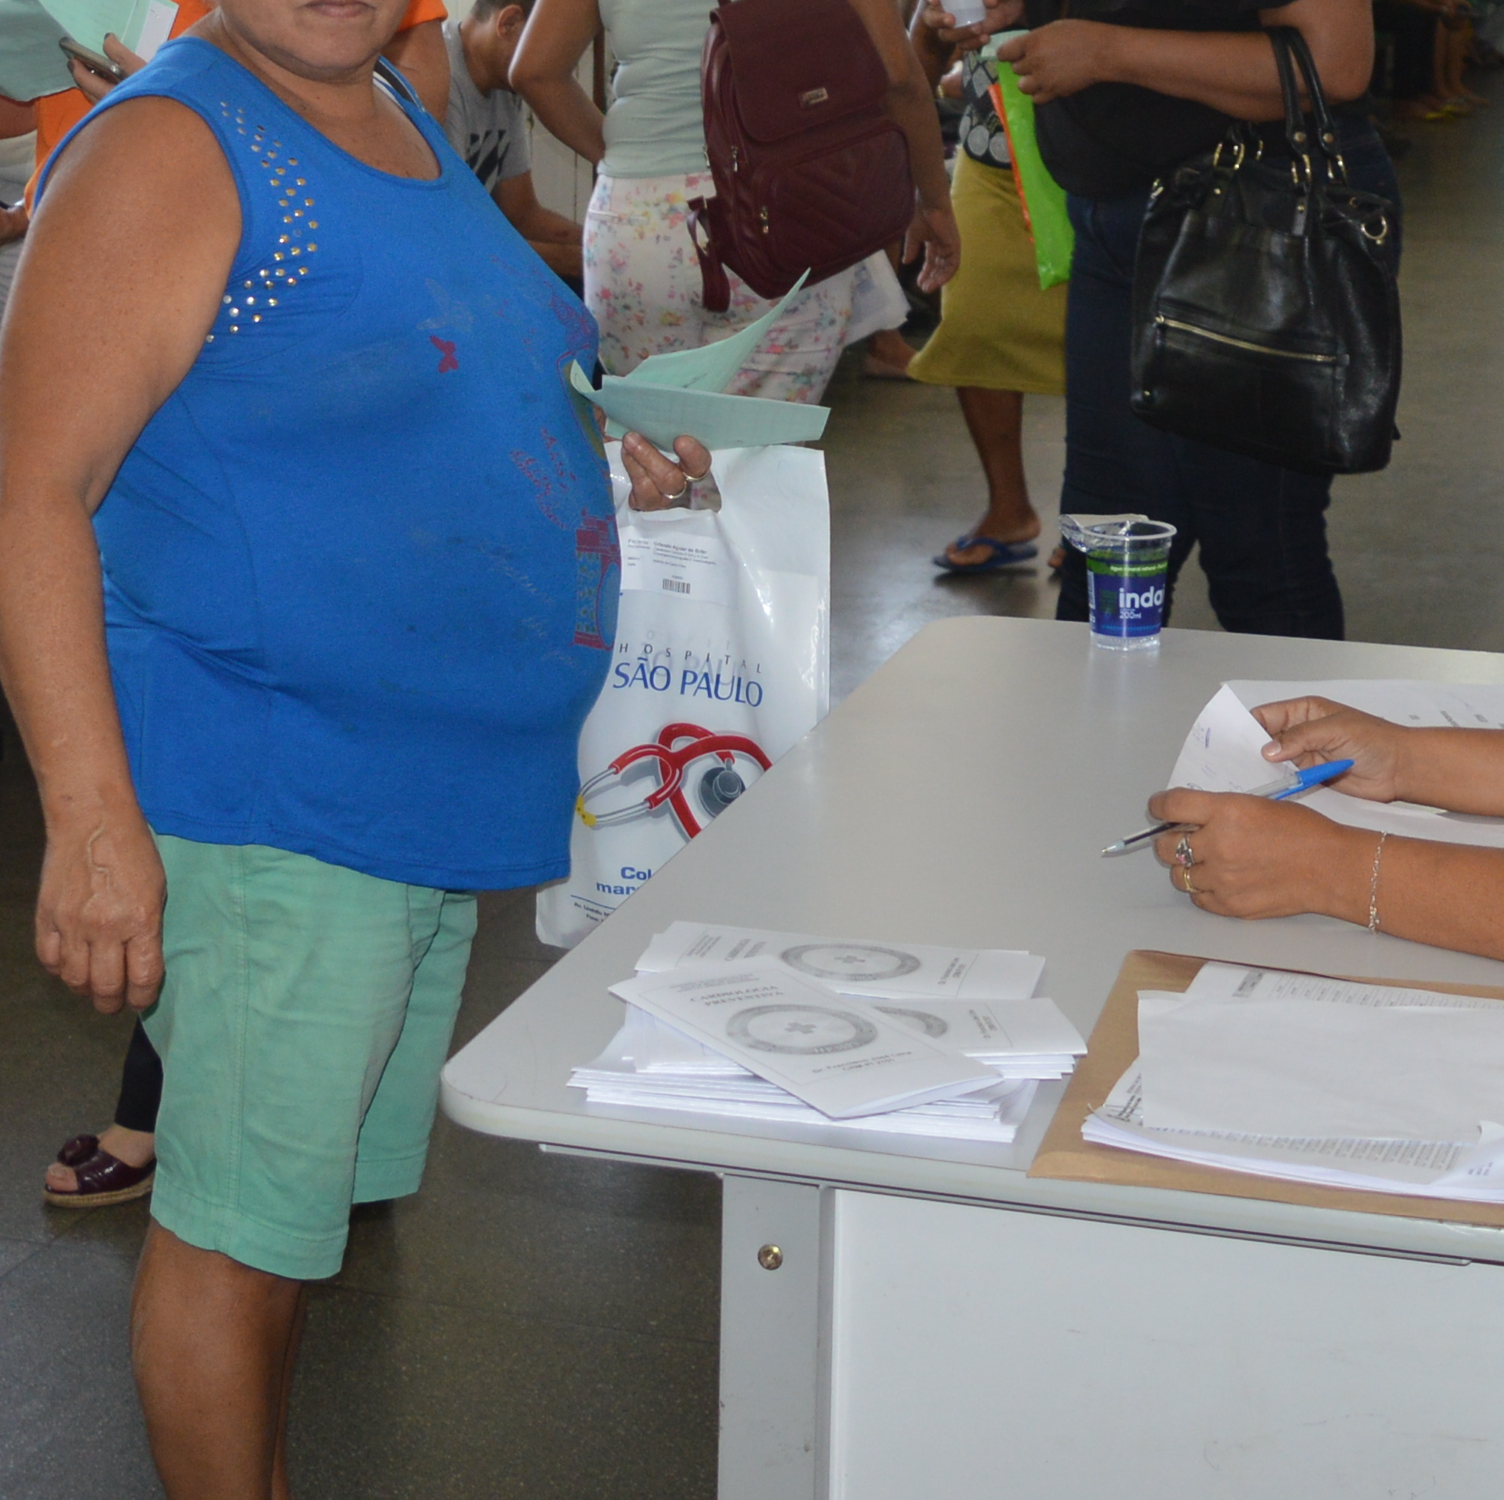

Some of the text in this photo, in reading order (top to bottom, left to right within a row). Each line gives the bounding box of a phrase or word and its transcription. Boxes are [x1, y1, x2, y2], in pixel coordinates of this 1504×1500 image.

[1119, 584, 1165, 608] inda
[619, 642, 762, 674] HOSPITAL
[613, 656, 763, 708] SÃO PAULO
